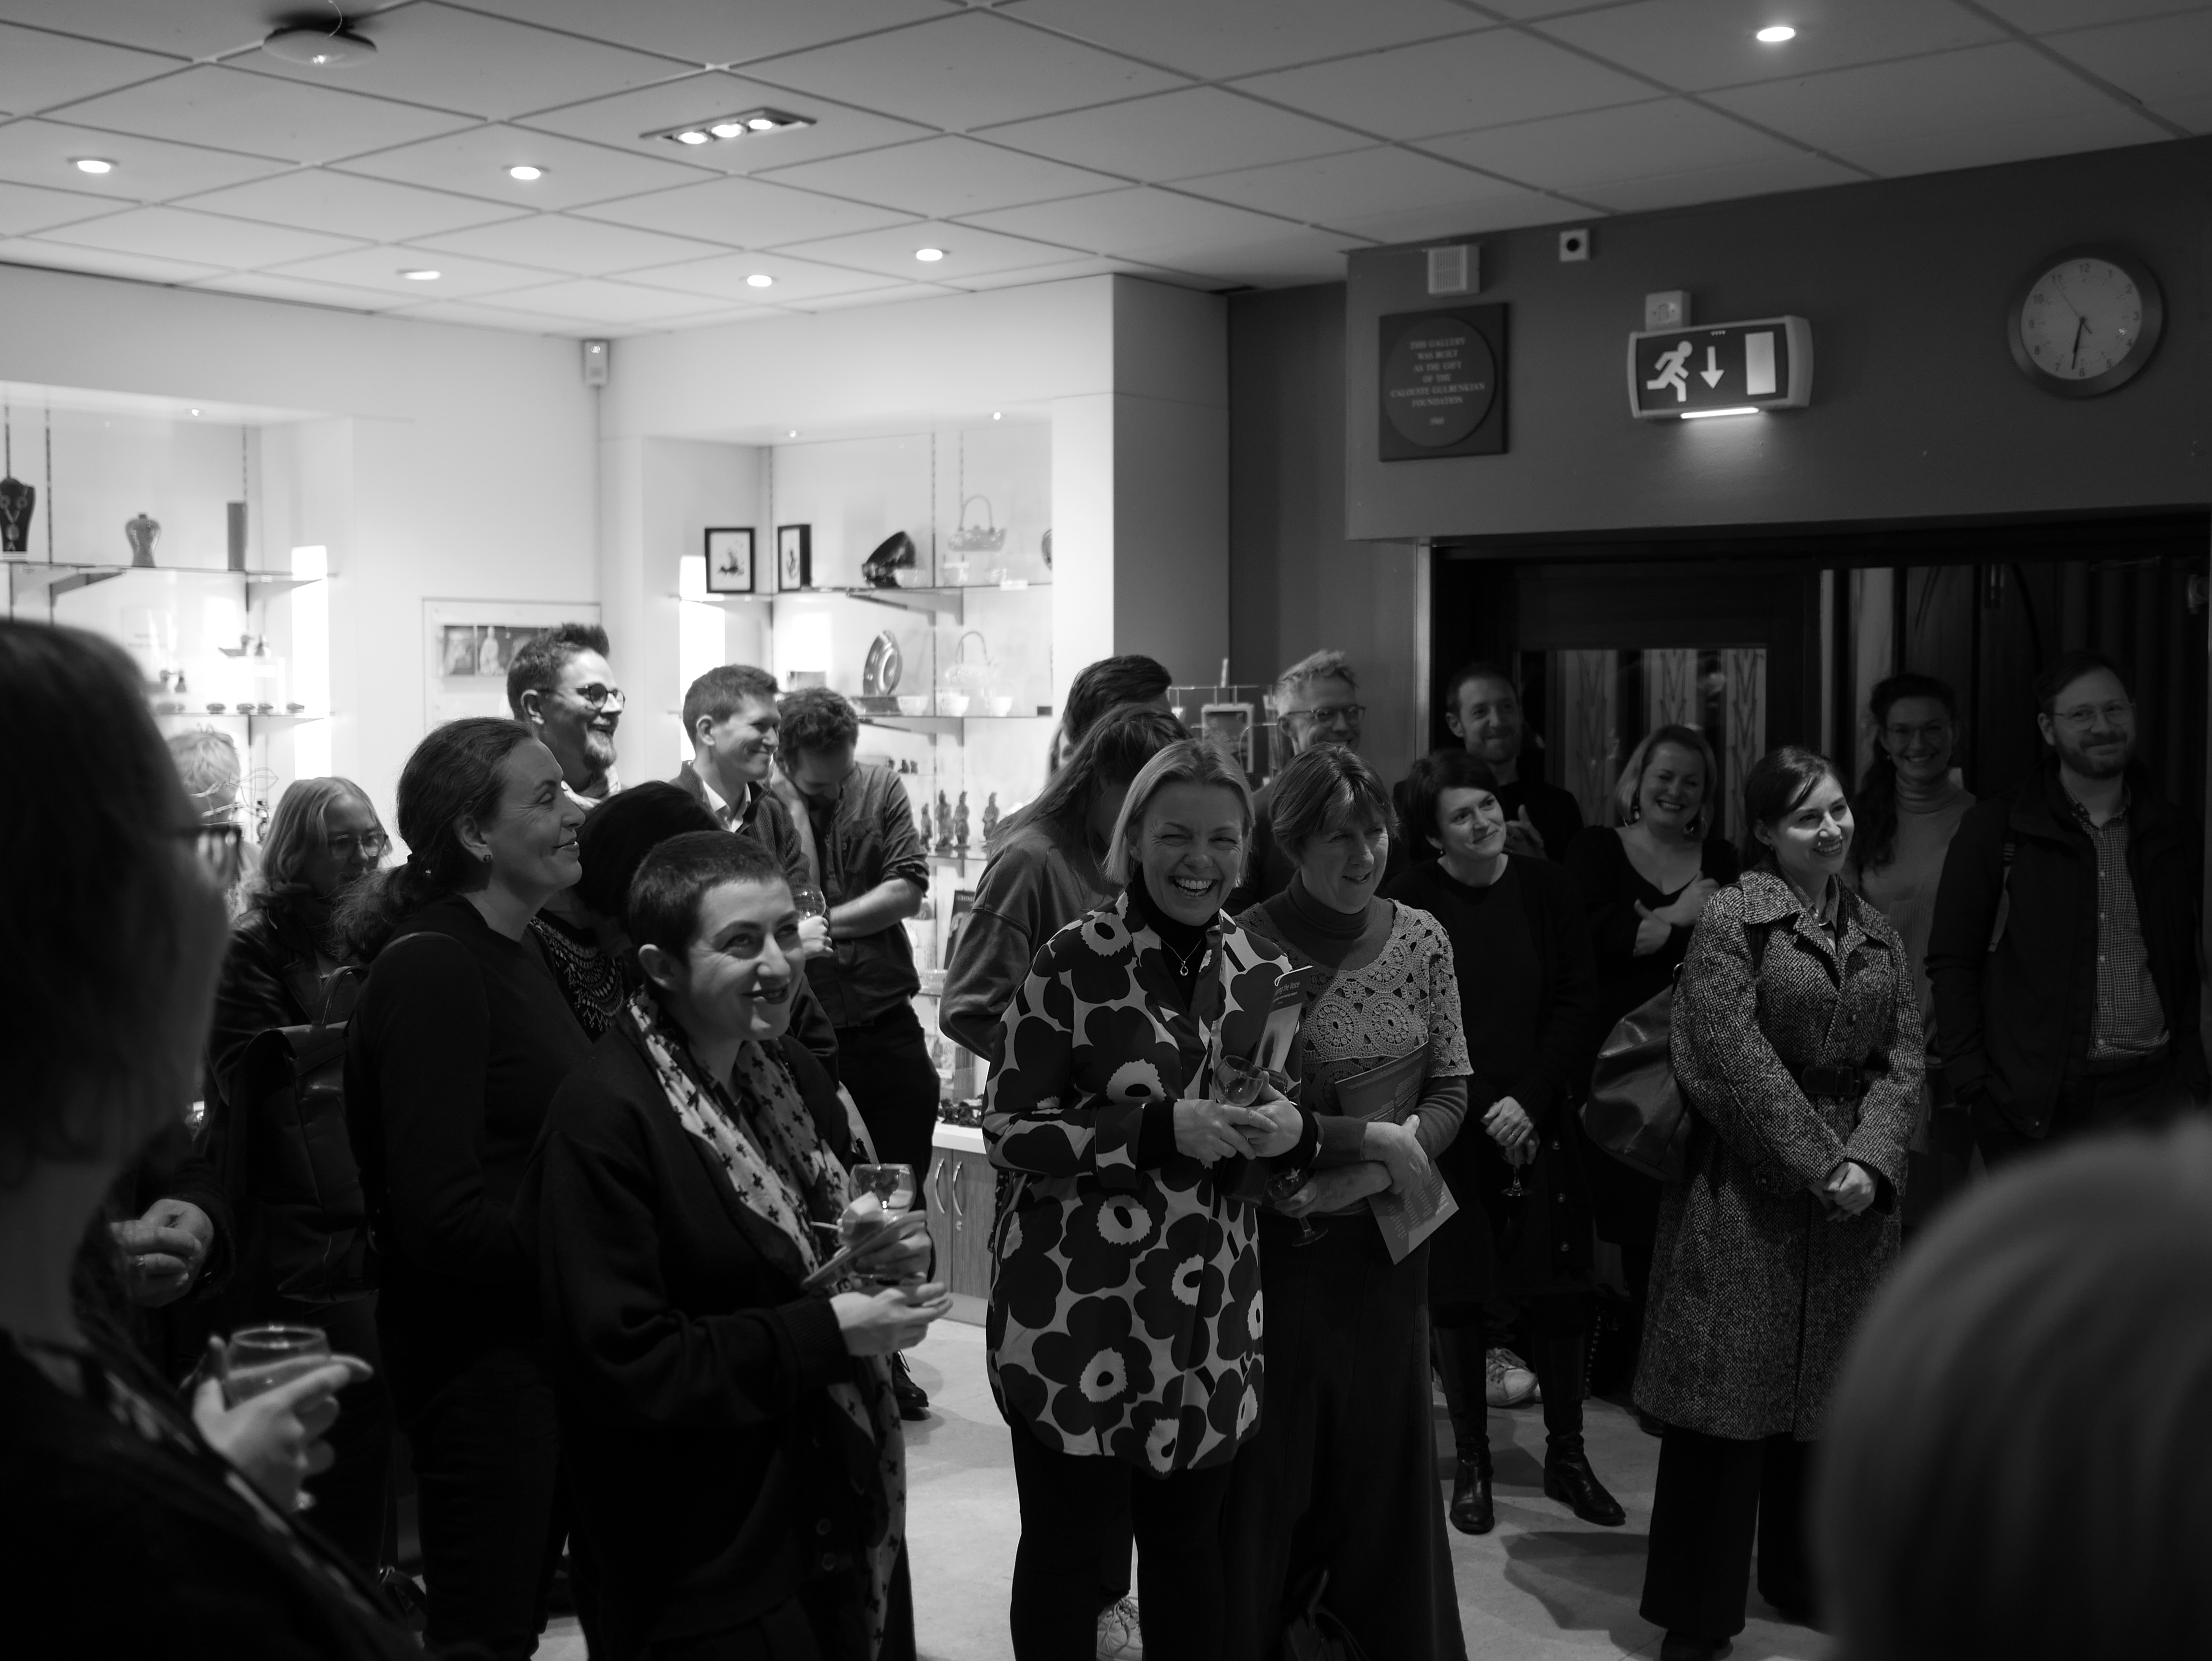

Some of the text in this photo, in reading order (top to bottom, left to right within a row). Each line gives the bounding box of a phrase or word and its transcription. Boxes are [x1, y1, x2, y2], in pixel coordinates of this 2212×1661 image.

[1410, 337, 1465, 350] THIS GALLERY
[1417, 349, 1459, 360] WAS BUILT
[1414, 360, 1462, 373] AS THE GIFT
[1422, 373, 1452, 383] OF THE
[1391, 383, 1485, 398] CALOUSTE GULBENKIAN
[1412, 396, 1462, 408] FOUNDATION
[1290, 981, 1300, 989] Voice
